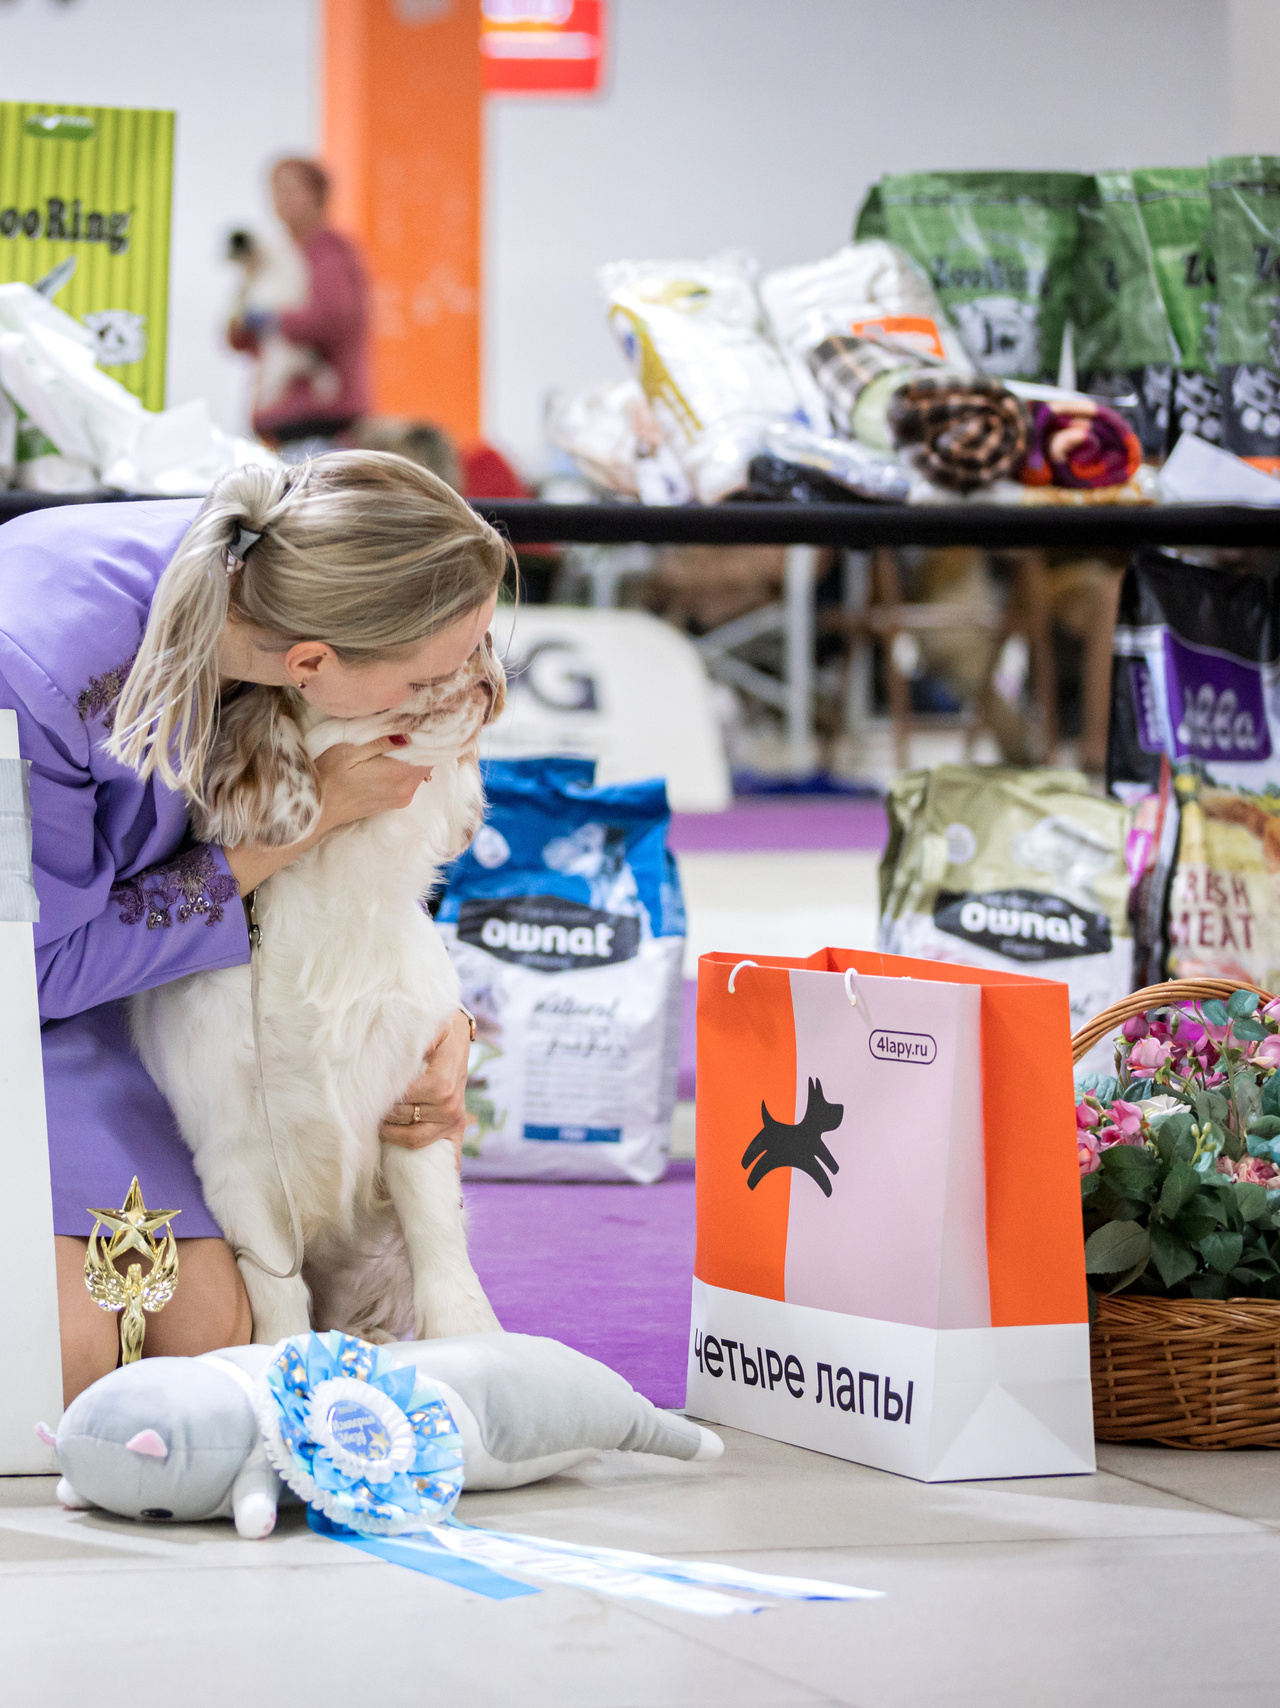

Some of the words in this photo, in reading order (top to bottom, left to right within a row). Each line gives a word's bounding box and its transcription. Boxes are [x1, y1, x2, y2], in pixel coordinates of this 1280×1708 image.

[481, 917, 616, 958] ownat
[960, 901, 1088, 948] ownat
[876, 1036, 928, 1059] 4lapy.ru
[695, 1328, 806, 1399] четыре
[816, 1362, 915, 1425] лапы
